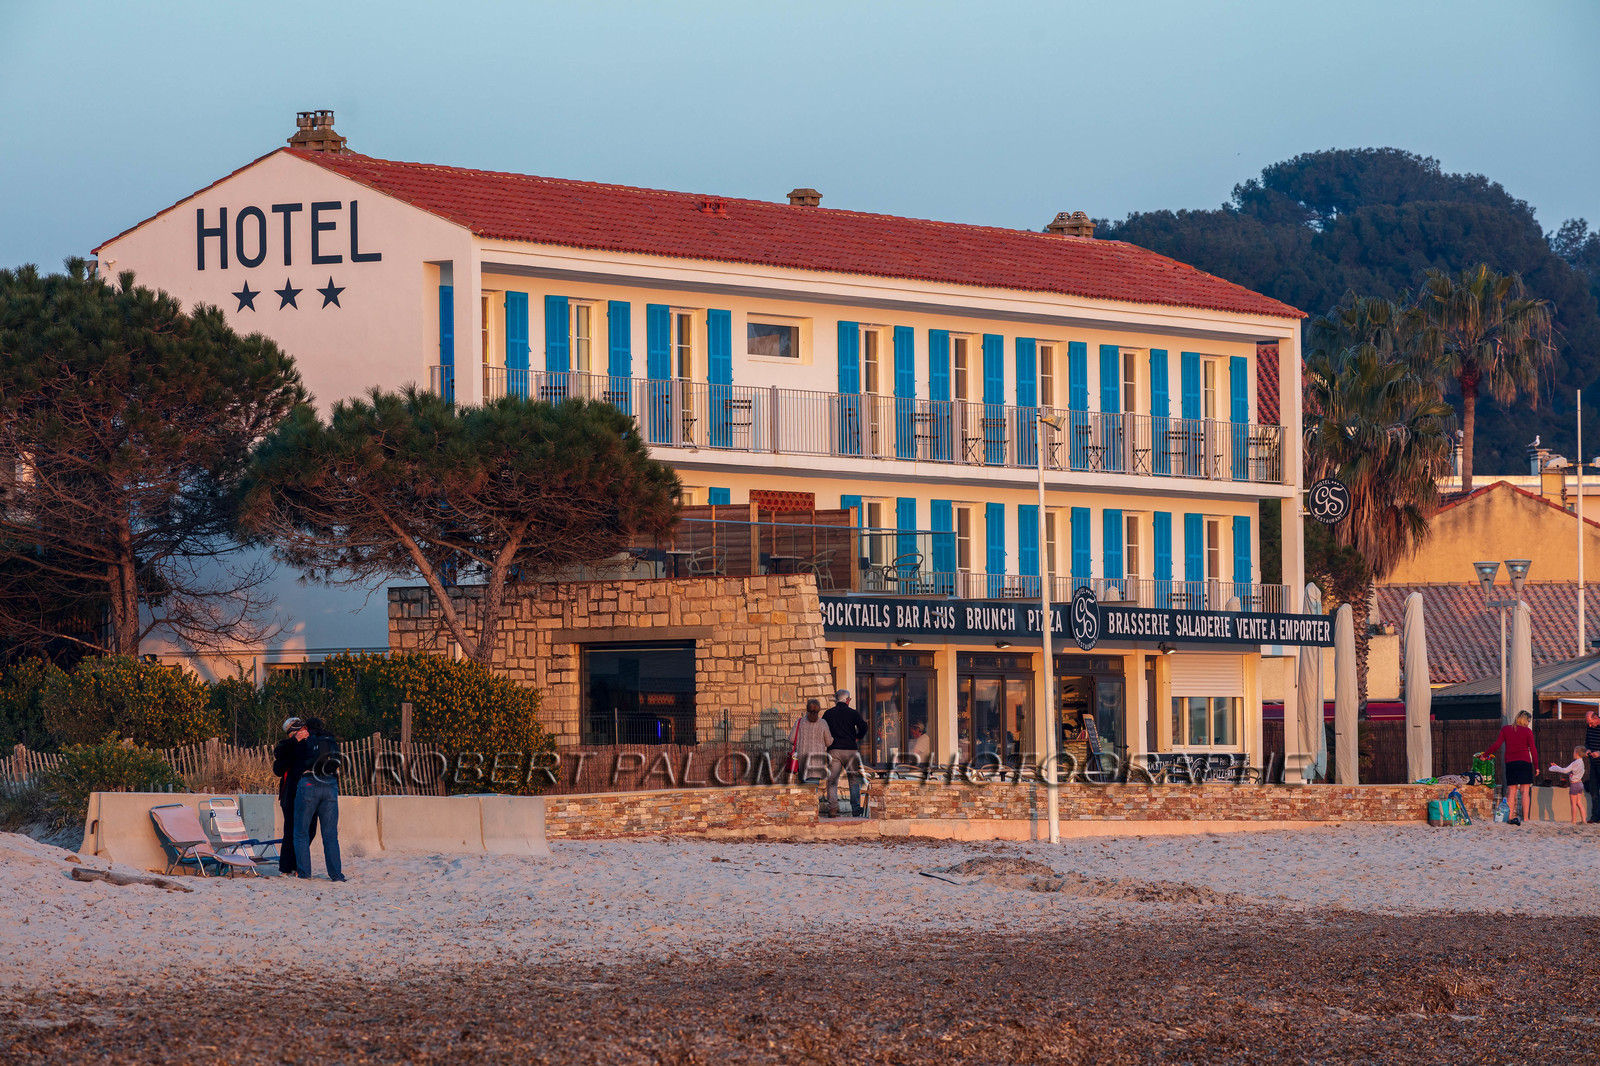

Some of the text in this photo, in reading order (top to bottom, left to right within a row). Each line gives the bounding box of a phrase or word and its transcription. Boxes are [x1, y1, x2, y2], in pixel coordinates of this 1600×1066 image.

[196, 200, 382, 271] HOTEL
[819, 601, 890, 628] COCKTAILS
[896, 605, 920, 628] BAR
[923, 605, 931, 628] A
[933, 606, 956, 629] JUS
[965, 607, 1016, 631] BRUNCH
[1108, 612, 1331, 642] BRASSERIE SALADERIE VENTE A EMPORTER
